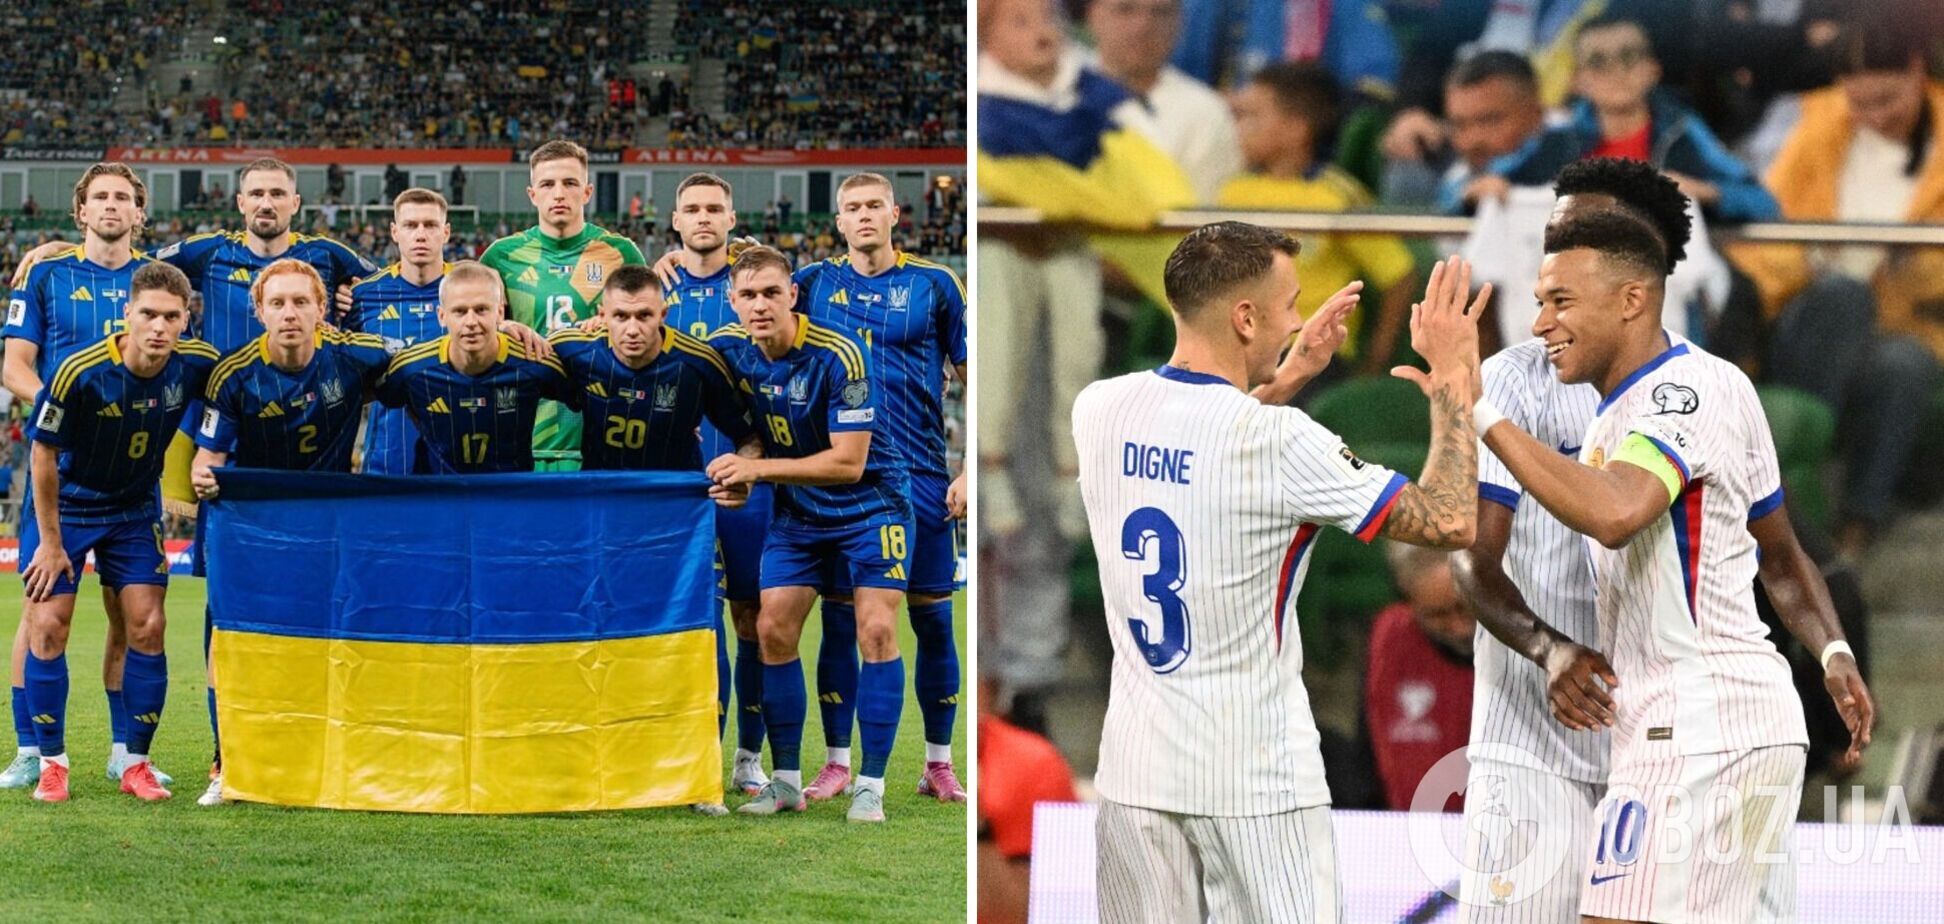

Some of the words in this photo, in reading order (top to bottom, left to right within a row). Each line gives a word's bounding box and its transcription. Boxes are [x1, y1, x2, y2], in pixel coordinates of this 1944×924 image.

[120, 149, 208, 161] ARENA
[636, 150, 728, 162] ARENA
[546, 295, 573, 330] 12
[128, 431, 150, 459] 8
[298, 424, 319, 453] 2
[605, 415, 647, 449] 20
[765, 413, 794, 447] 18
[461, 432, 490, 465] 17
[1122, 441, 1195, 485] DIGNE
[880, 524, 908, 561] 18
[1121, 506, 1193, 675] 3
[1594, 798, 1648, 867] 10
